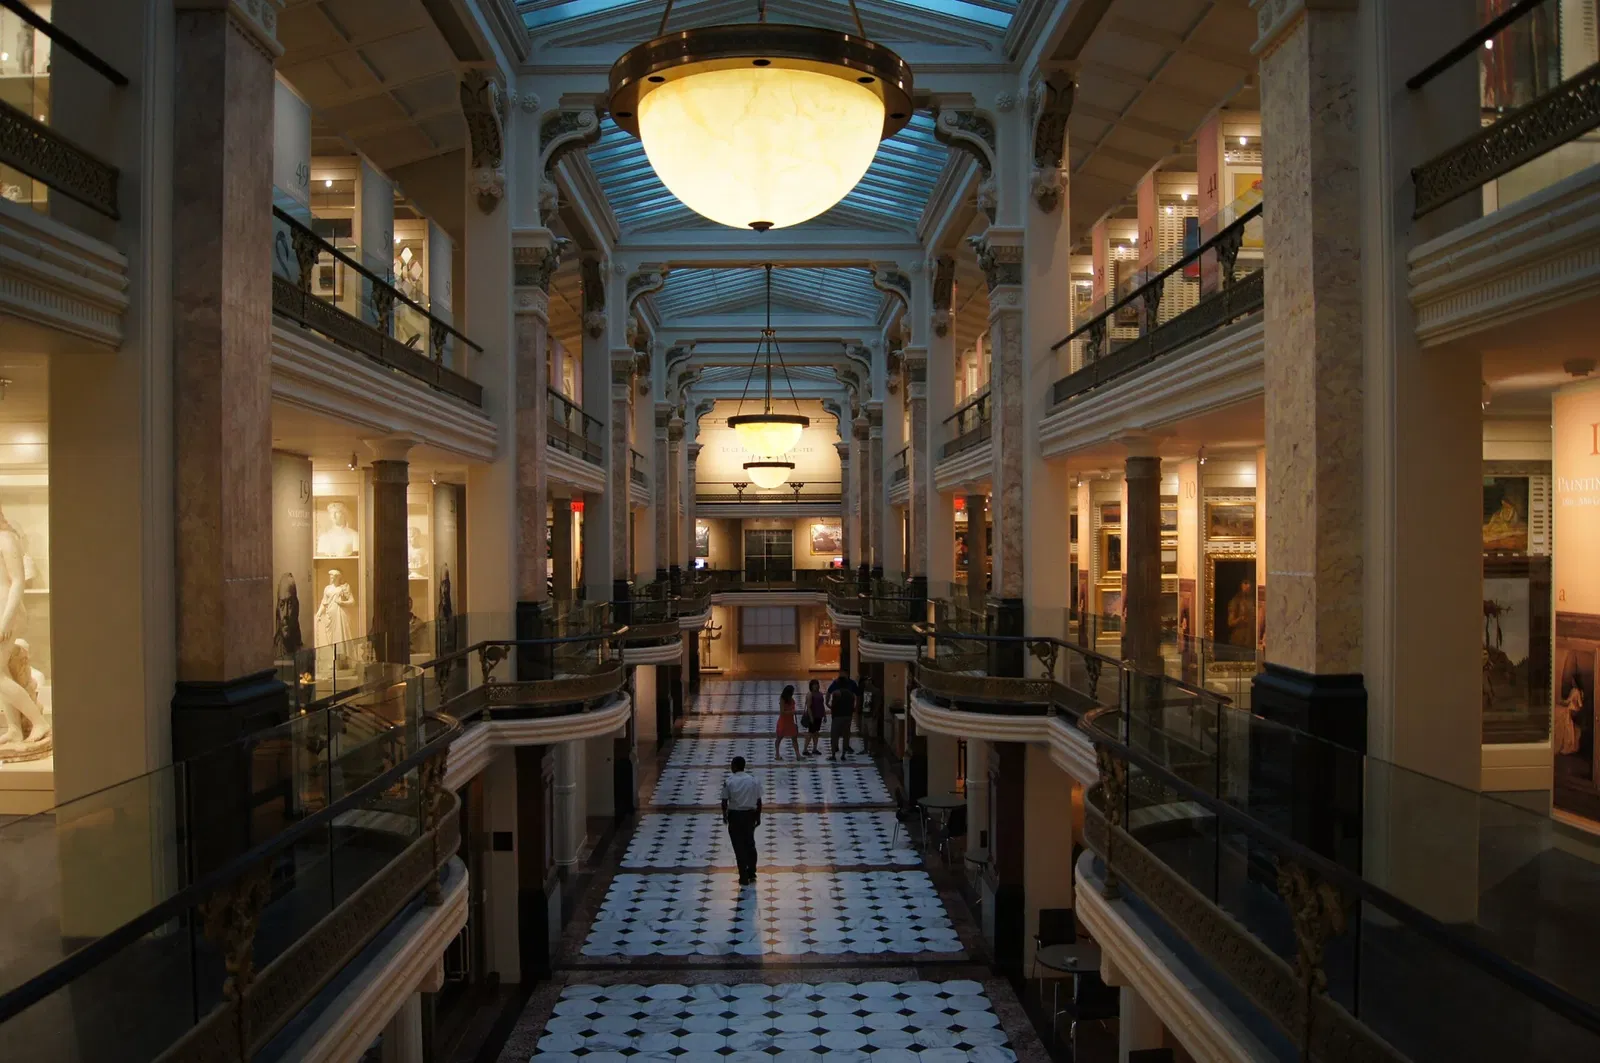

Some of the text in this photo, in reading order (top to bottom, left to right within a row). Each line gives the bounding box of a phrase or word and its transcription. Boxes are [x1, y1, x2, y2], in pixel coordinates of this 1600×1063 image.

[1206, 173, 1218, 198] 41
[299, 479, 310, 504] 19
[1185, 481, 1196, 499] 10
